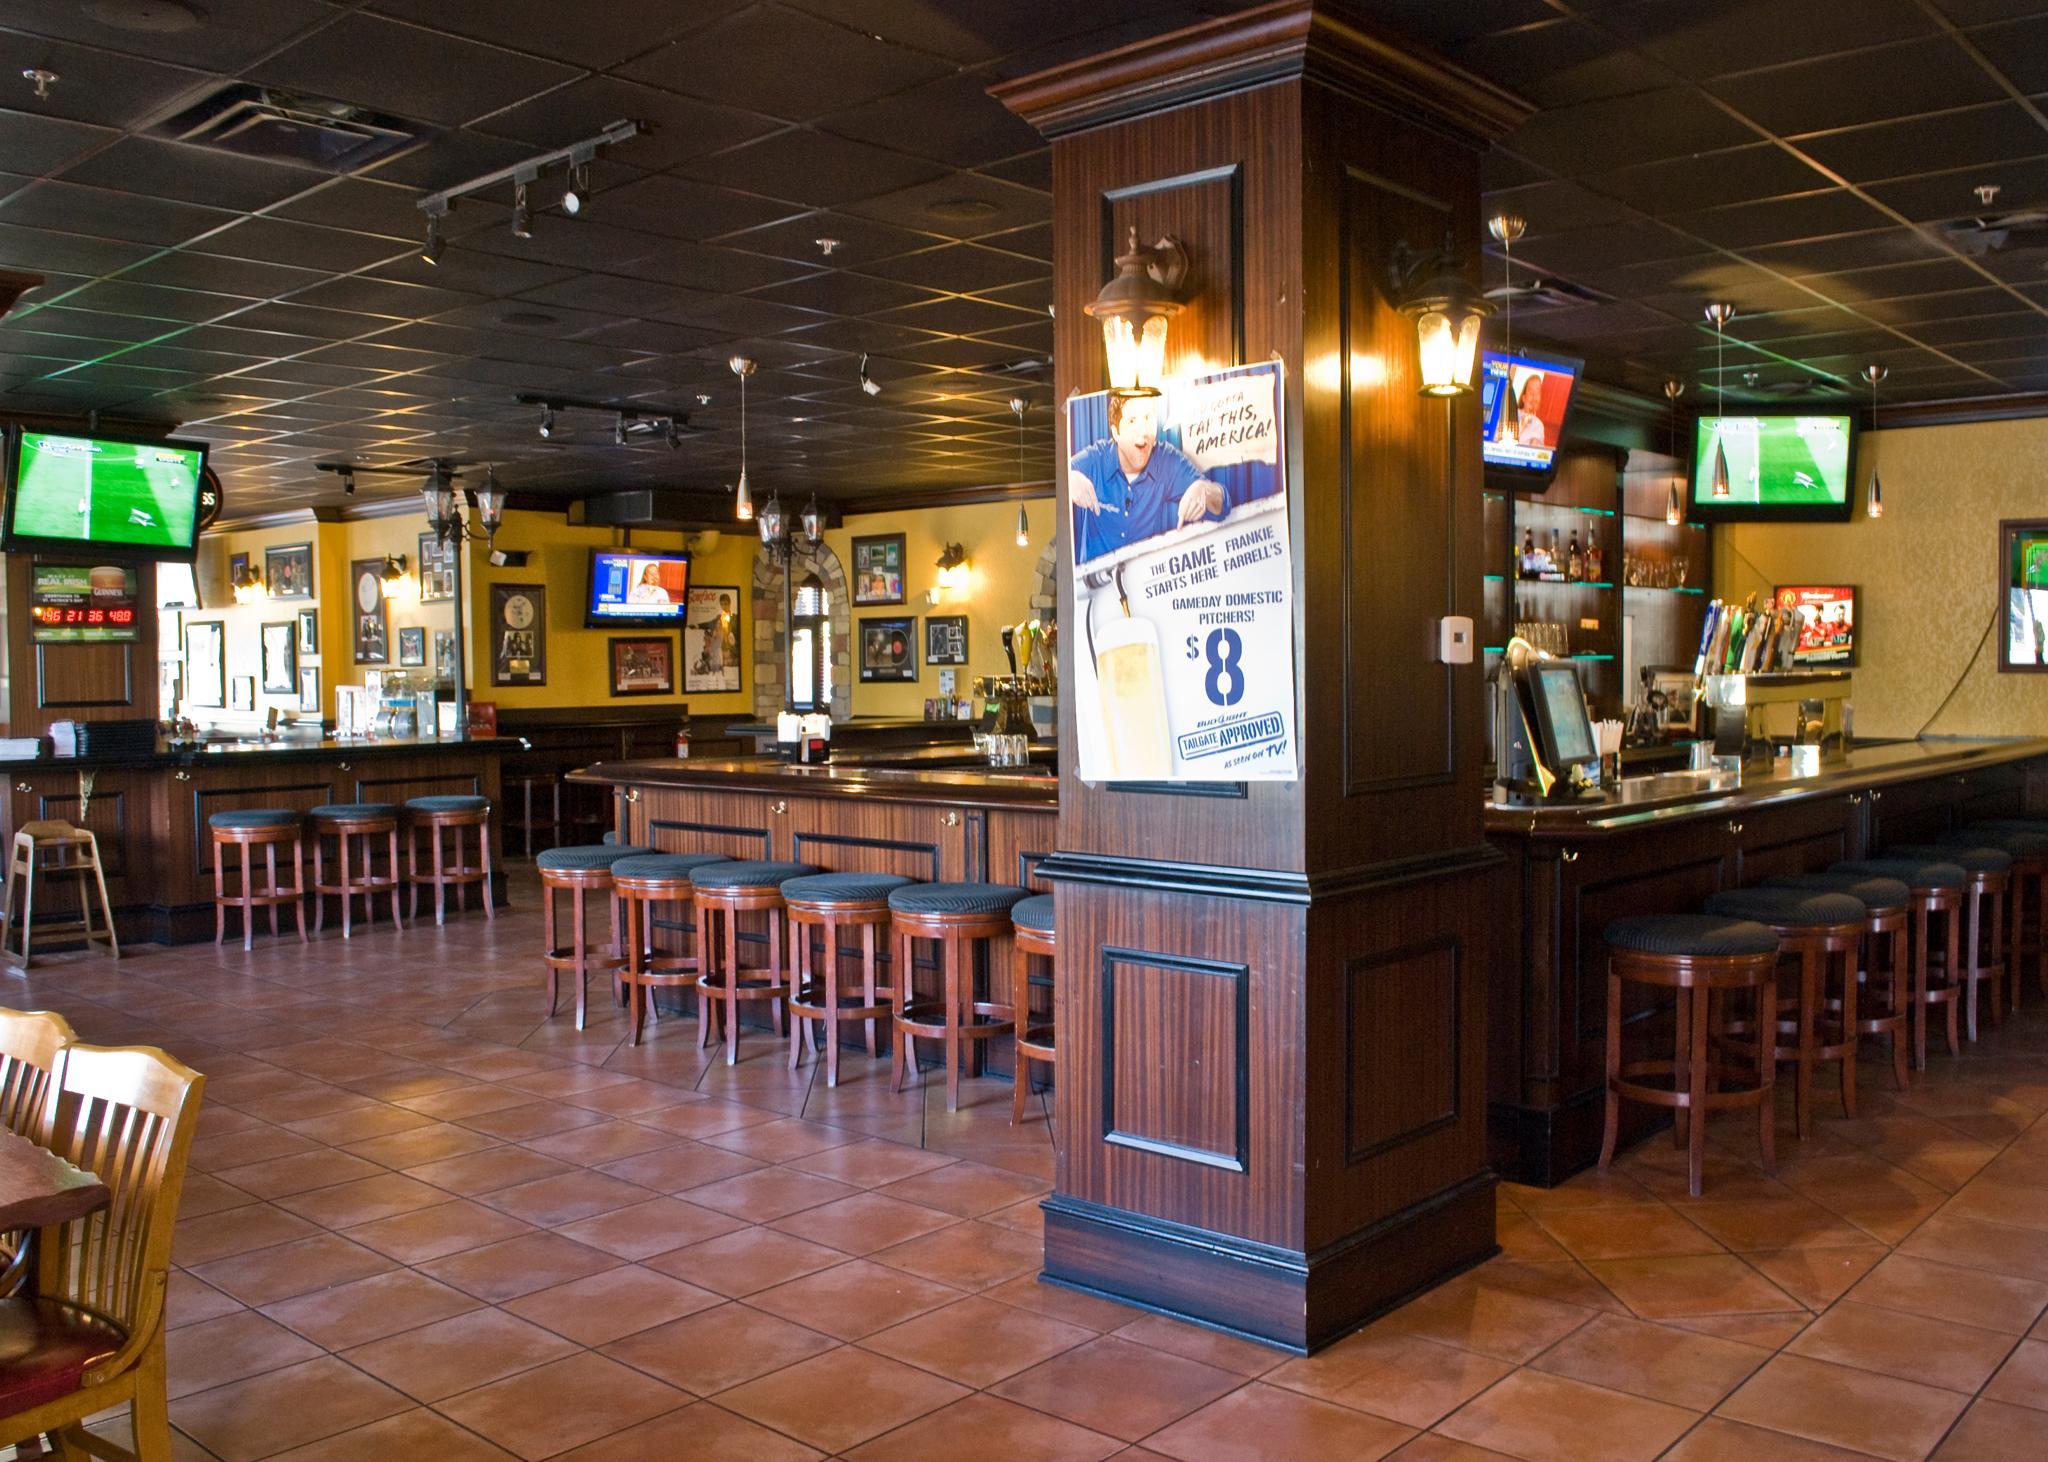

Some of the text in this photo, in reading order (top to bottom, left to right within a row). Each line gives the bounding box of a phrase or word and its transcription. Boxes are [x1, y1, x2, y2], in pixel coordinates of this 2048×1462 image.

[1219, 404, 1257, 427] THIS,
[1196, 418, 1272, 455] AMERICA!
[1225, 525, 1275, 553] FRANKIE
[1150, 543, 1217, 576] THE GAME
[1223, 541, 1283, 572] FARRELL'S
[37, 578, 88, 586] REAL IRISH
[94, 588, 124, 597] GUINNESS
[1145, 565, 1219, 599] STARTS HERE
[1172, 590, 1283, 610] GAMEDAY DOMESTIC
[65, 609, 83, 622] 21
[87, 609, 104, 622] 36
[1199, 609, 1255, 625] PITCHERS!
[1183, 716, 1280, 751] TAILGATE APPROVED
[1224, 739, 1288, 769] AS SEEN ON TV!
